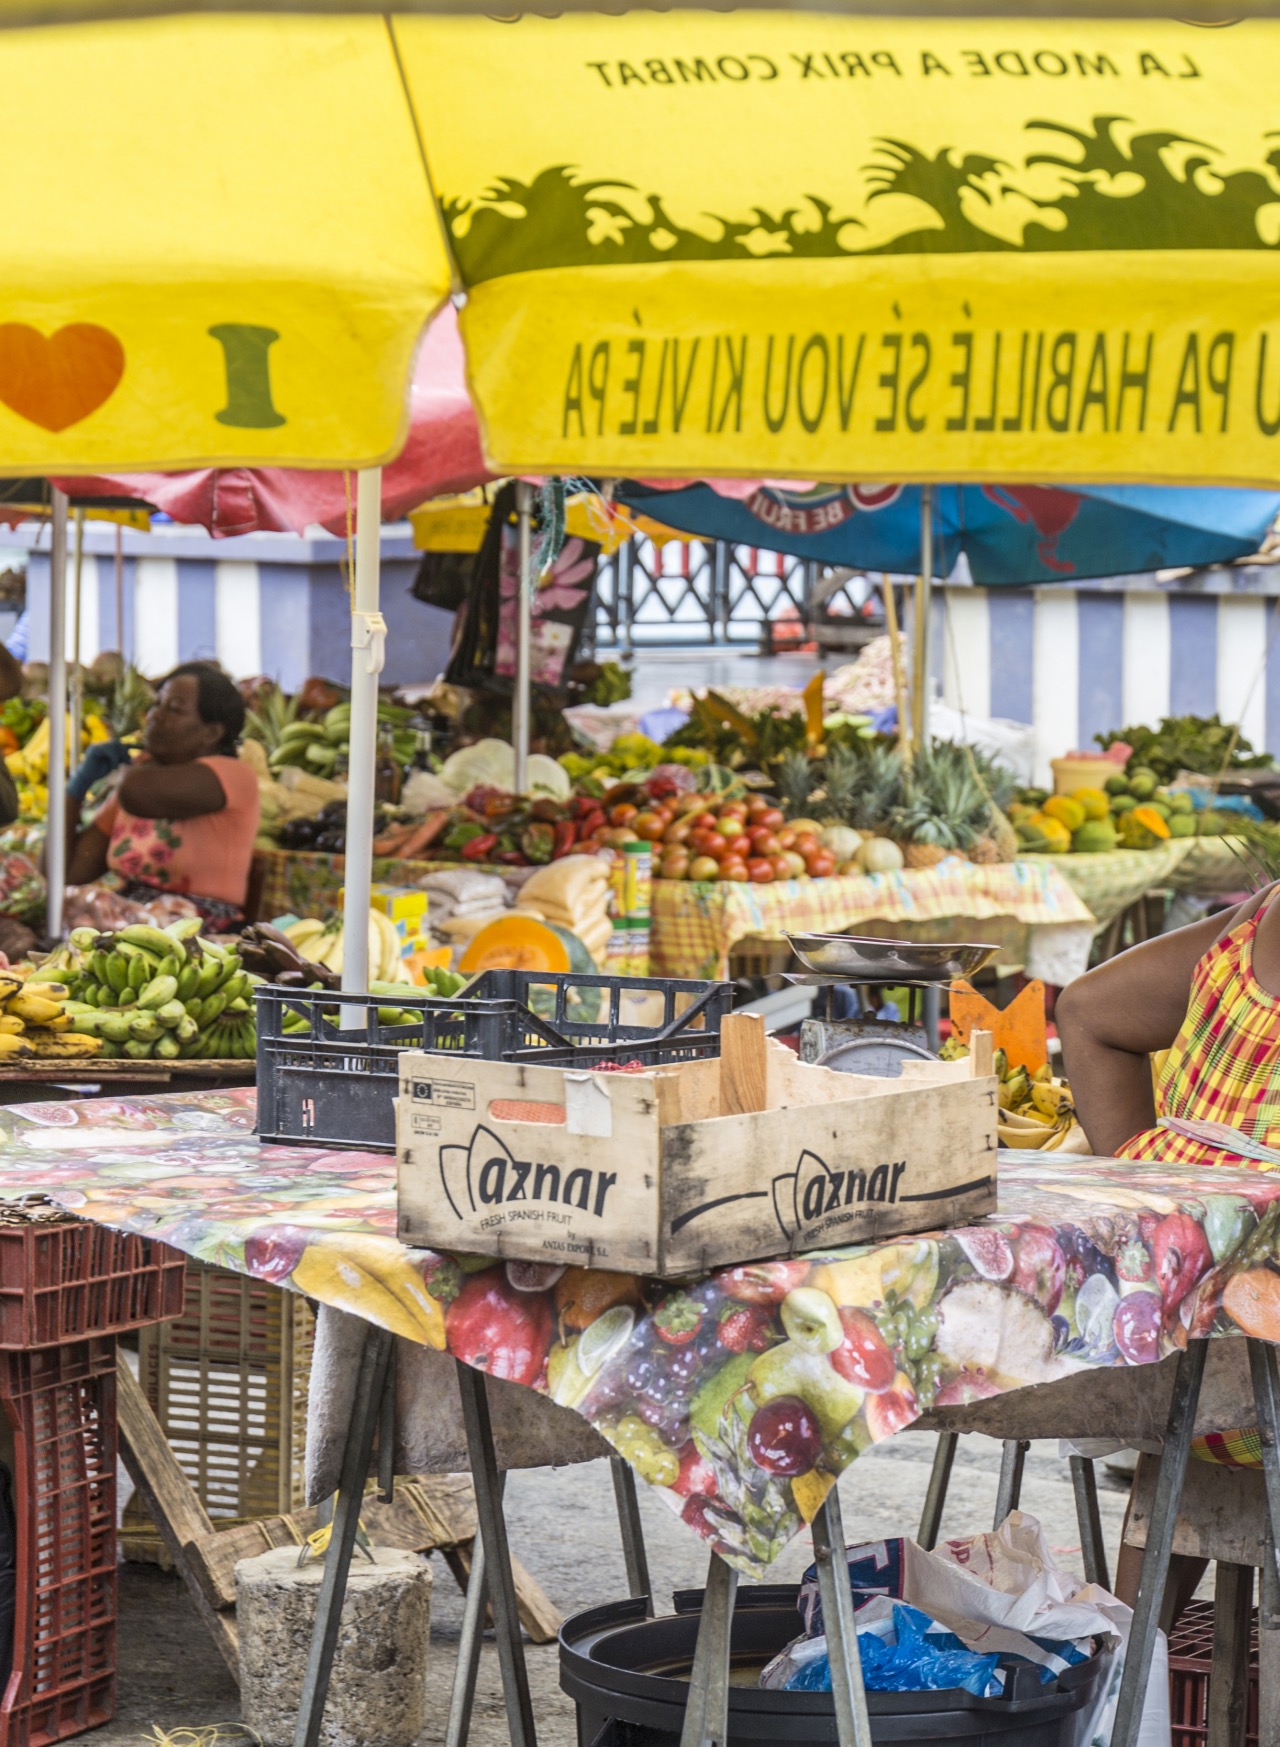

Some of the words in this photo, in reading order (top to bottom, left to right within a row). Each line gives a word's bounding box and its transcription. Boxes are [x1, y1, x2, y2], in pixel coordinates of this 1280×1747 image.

[479, 1157, 617, 1218] aznar
[803, 1160, 906, 1221] aznar
[480, 1210, 506, 1231] FRESH
[508, 1209, 545, 1223] SPANISH
[547, 1211, 572, 1226] FRUIT
[803, 1223, 825, 1242] FRESH
[825, 1211, 854, 1229] SPANISH
[855, 1209, 875, 1223] FRUIT
[542, 1239, 565, 1251] ANTAS
